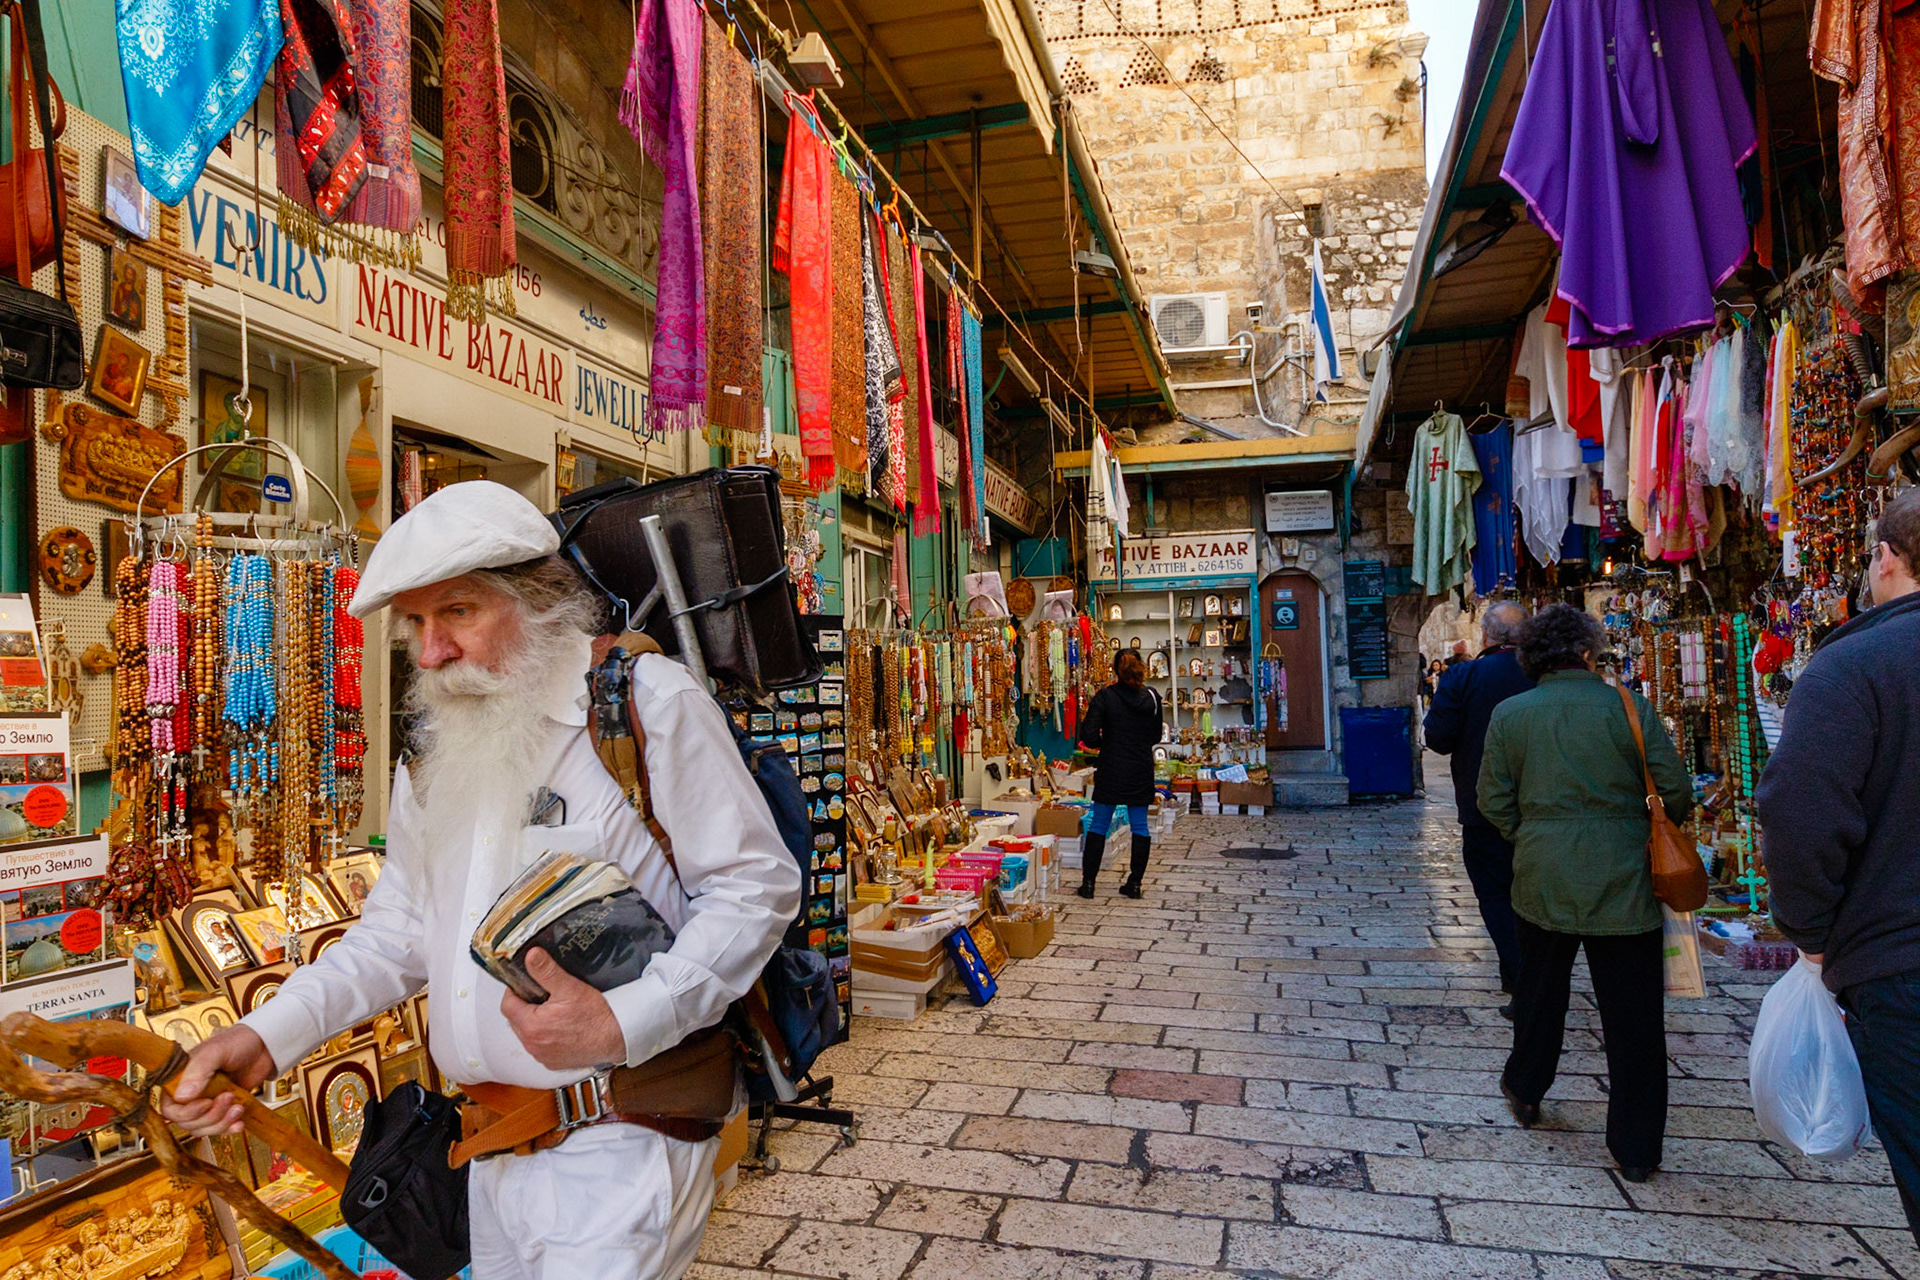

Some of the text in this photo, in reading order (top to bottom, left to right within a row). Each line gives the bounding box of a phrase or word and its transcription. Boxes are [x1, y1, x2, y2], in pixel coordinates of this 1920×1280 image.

[511, 263, 542, 297] 156
[355, 262, 563, 406] NATIVE BAZAAR
[985, 472, 1011, 512] NATIVE
[1172, 541, 1248, 559] BAZAAR
[1100, 565, 1133, 577] Prp.
[1198, 558, 1244, 572] 6264156
[10, 731, 53, 744] Землю
[5, 848, 75, 865] Путешествие в
[45, 857, 92, 873] Землю
[577, 923, 608, 951] Bible
[40, 984, 70, 996] NOSTRO
[26, 996, 66, 1013] TERRA
[68, 988, 106, 1003] SANTA
